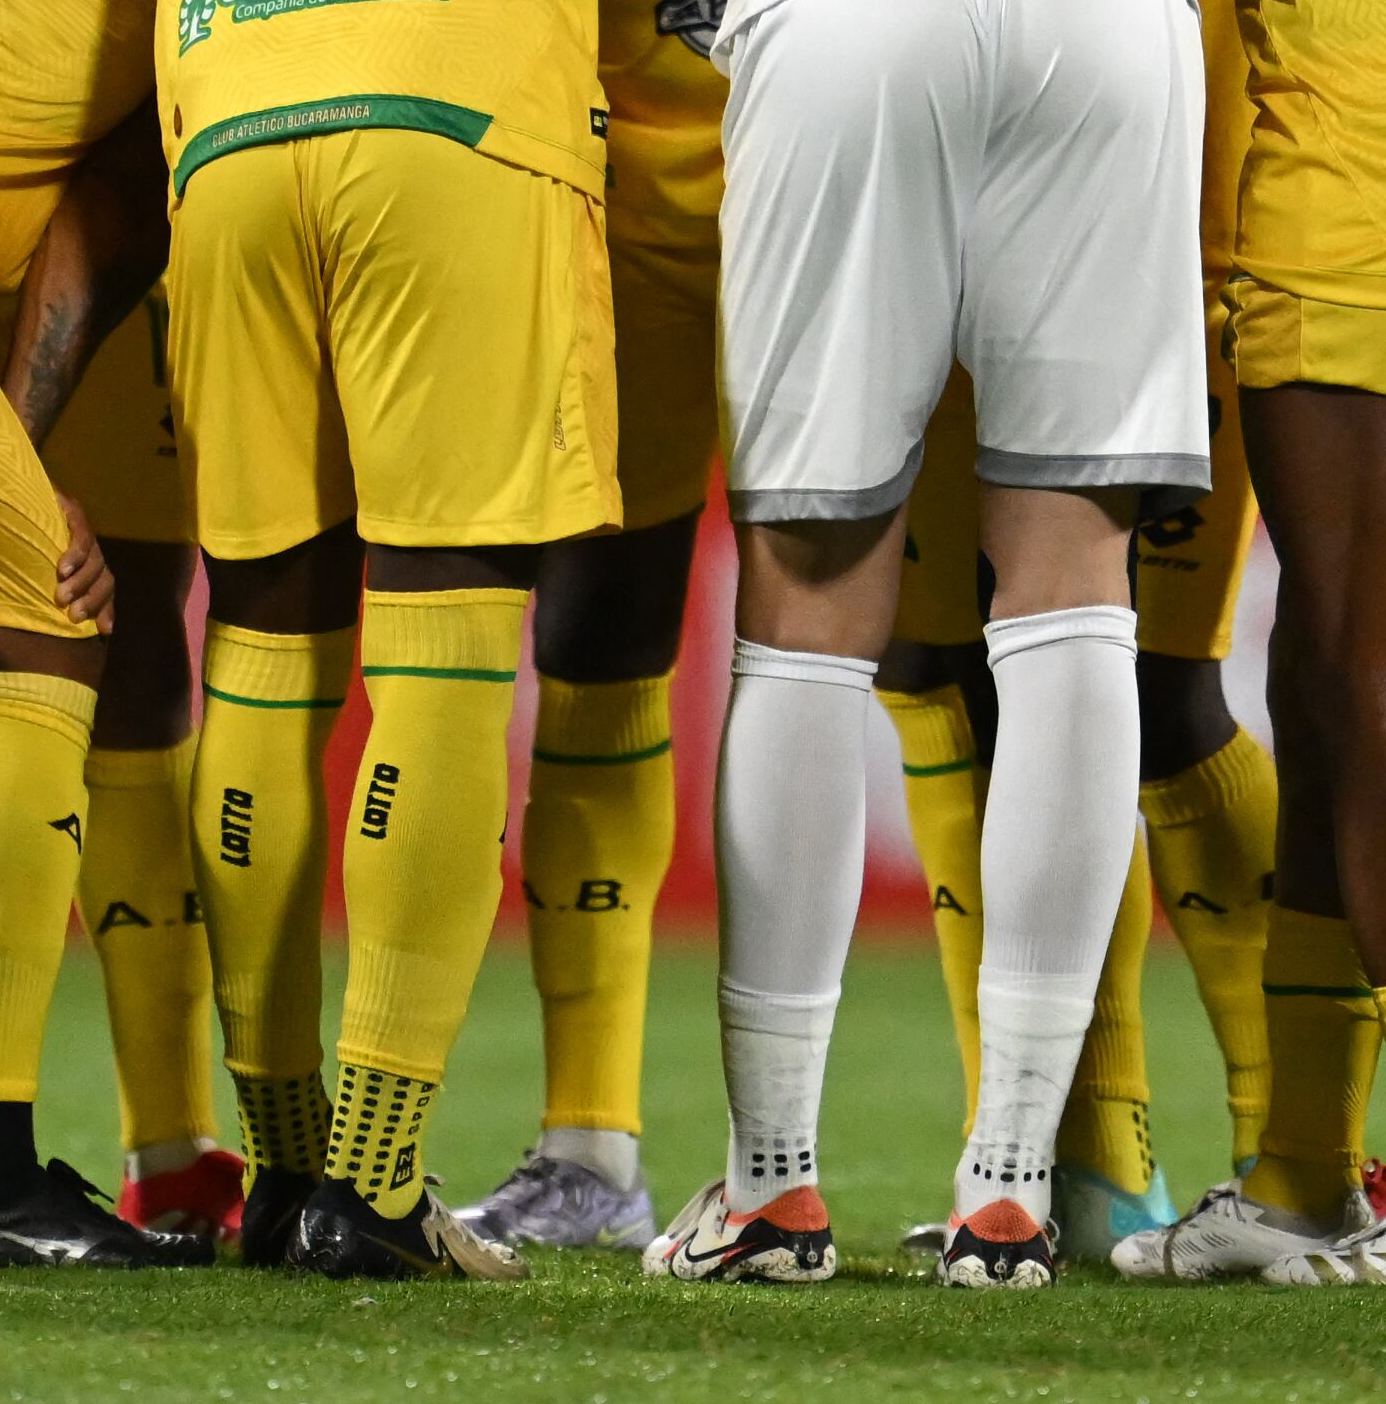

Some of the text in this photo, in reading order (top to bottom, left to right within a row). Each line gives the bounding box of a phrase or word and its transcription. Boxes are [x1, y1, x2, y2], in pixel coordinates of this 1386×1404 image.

[286, 104, 371, 129] BUCARAMANGA
[220, 787, 255, 868] LOTTO
[360, 762, 401, 840] LOTTO
